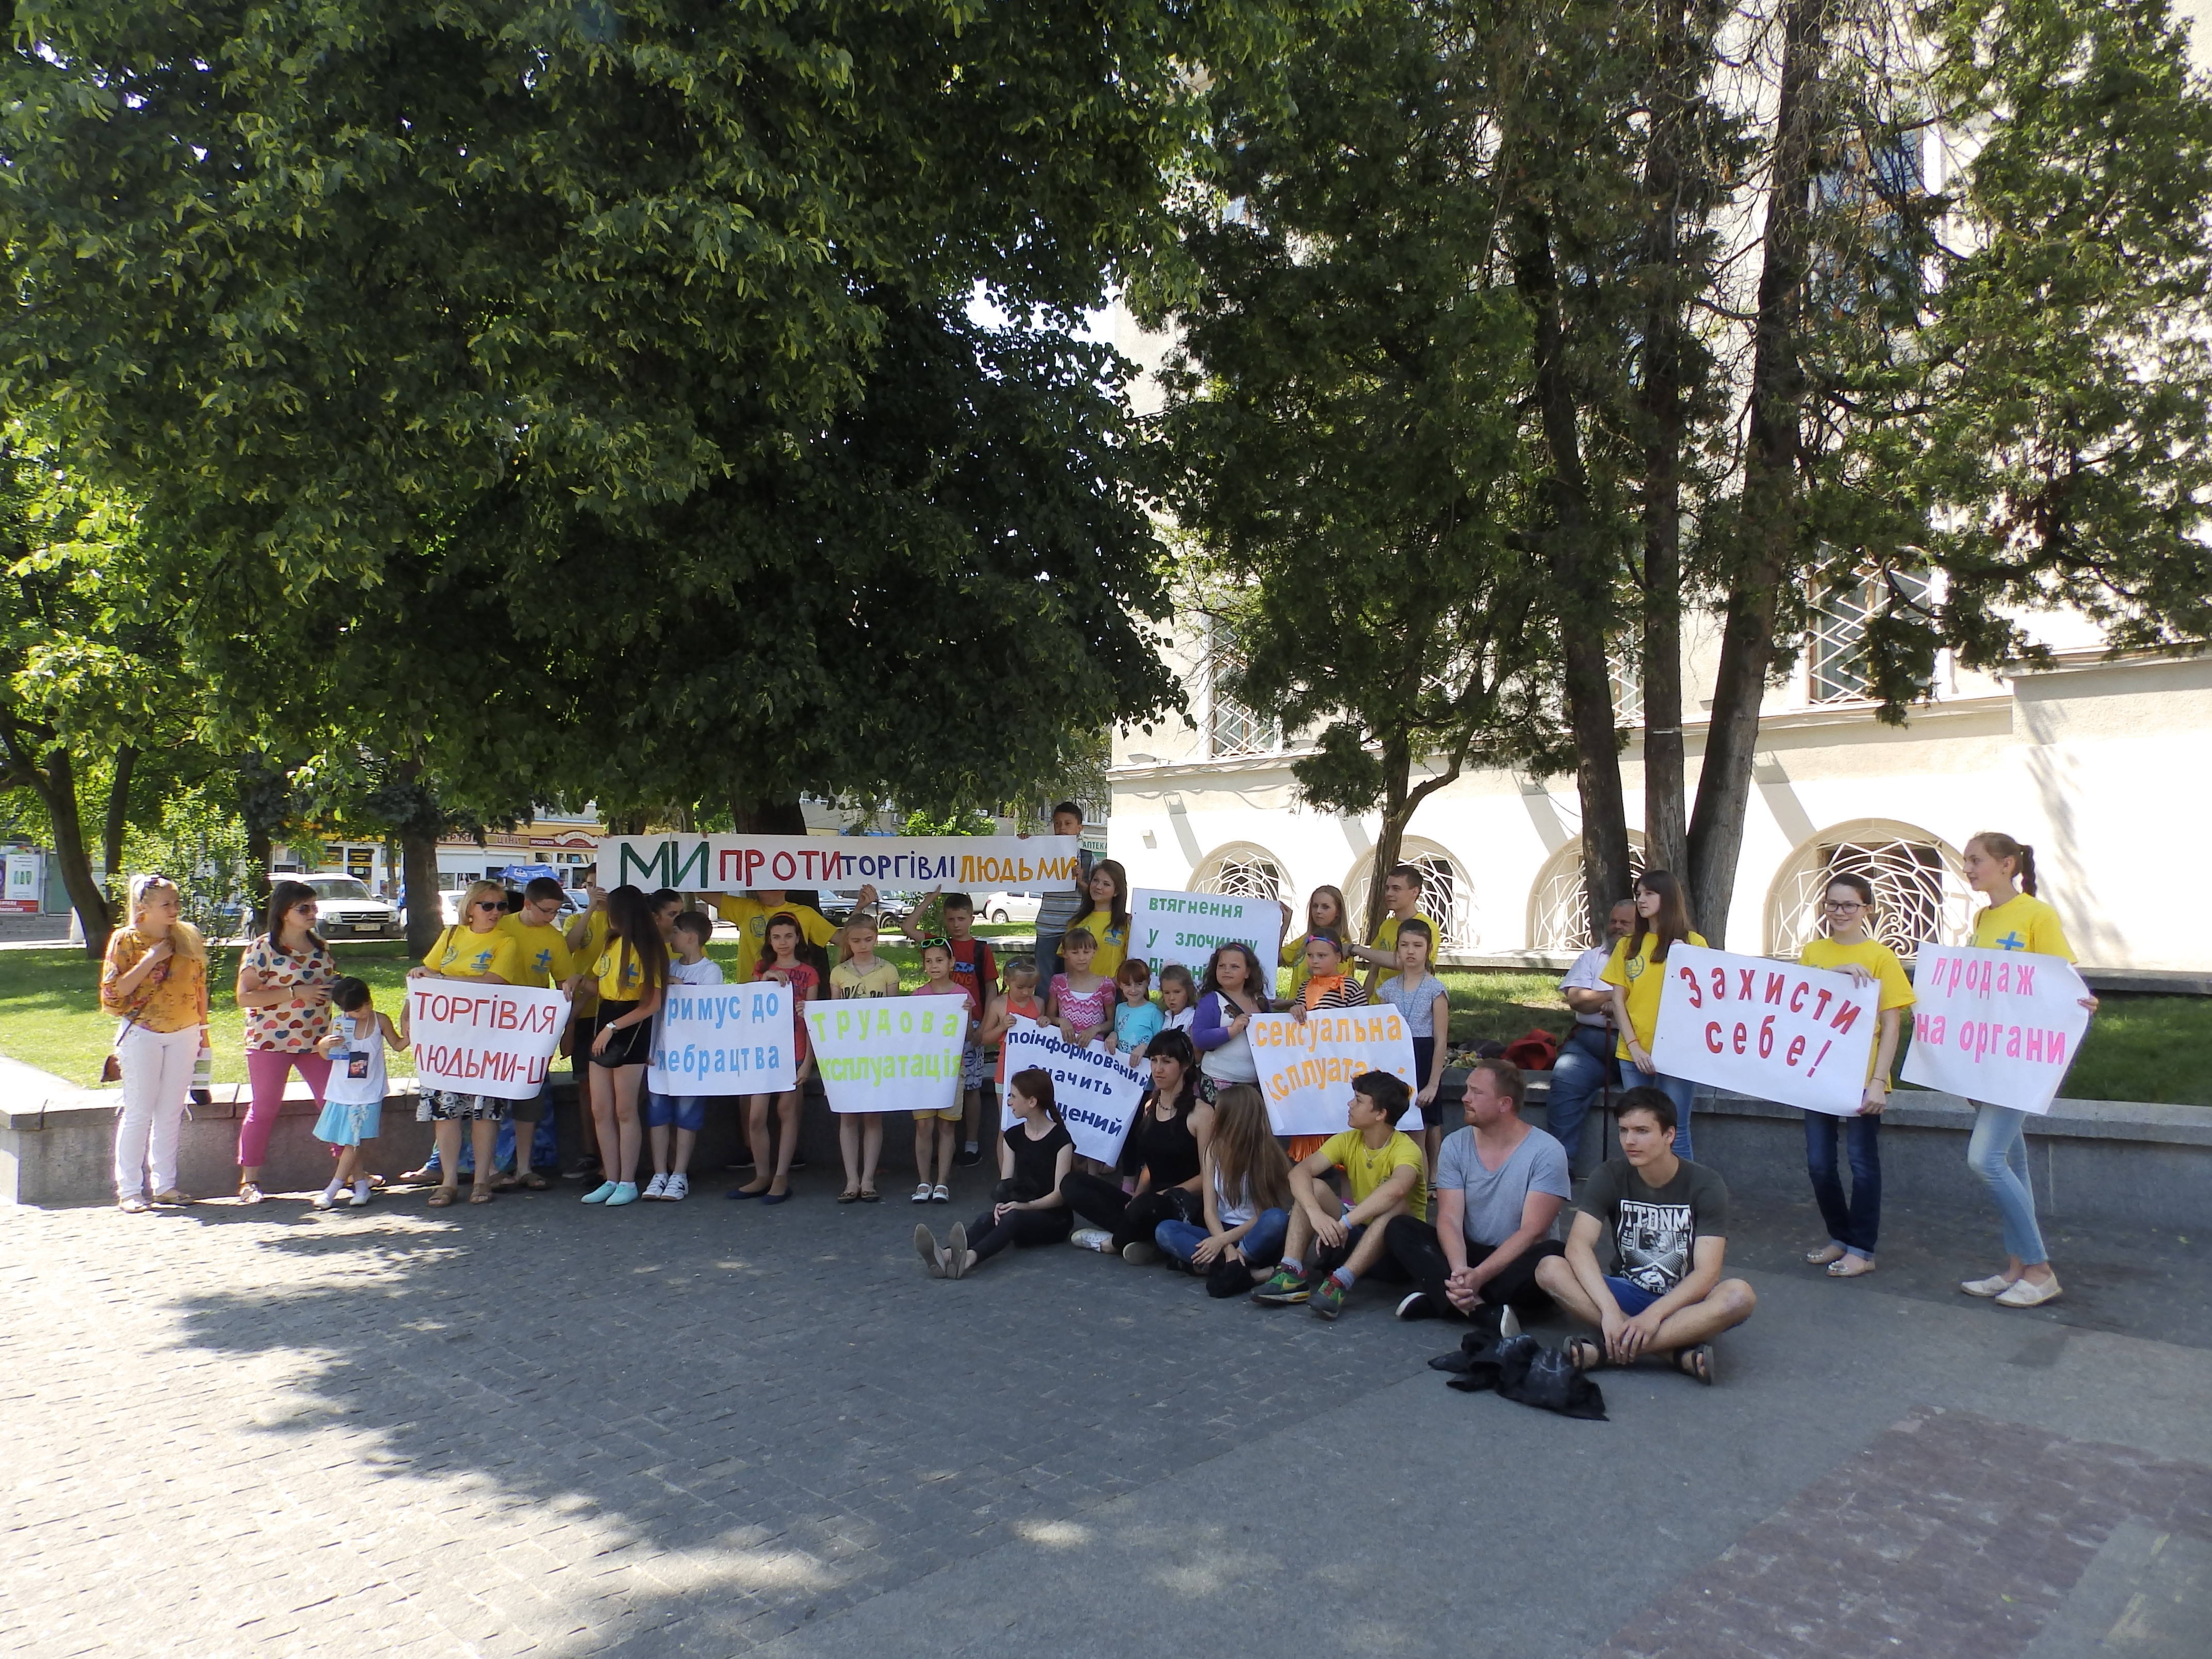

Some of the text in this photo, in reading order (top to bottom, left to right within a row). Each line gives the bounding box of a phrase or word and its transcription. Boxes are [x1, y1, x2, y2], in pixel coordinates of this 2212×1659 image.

[620, 841, 1076, 888] МИ ПРОТИ ТОРГІВЛІ ЛЮДЬМИ
[1931, 957, 2037, 1000] продаж
[414, 991, 557, 1034] ТОРГІВЛЯ
[753, 993, 778, 1023] до
[1705, 1015, 1832, 1078] себе!
[1916, 1013, 2065, 1065] на органи
